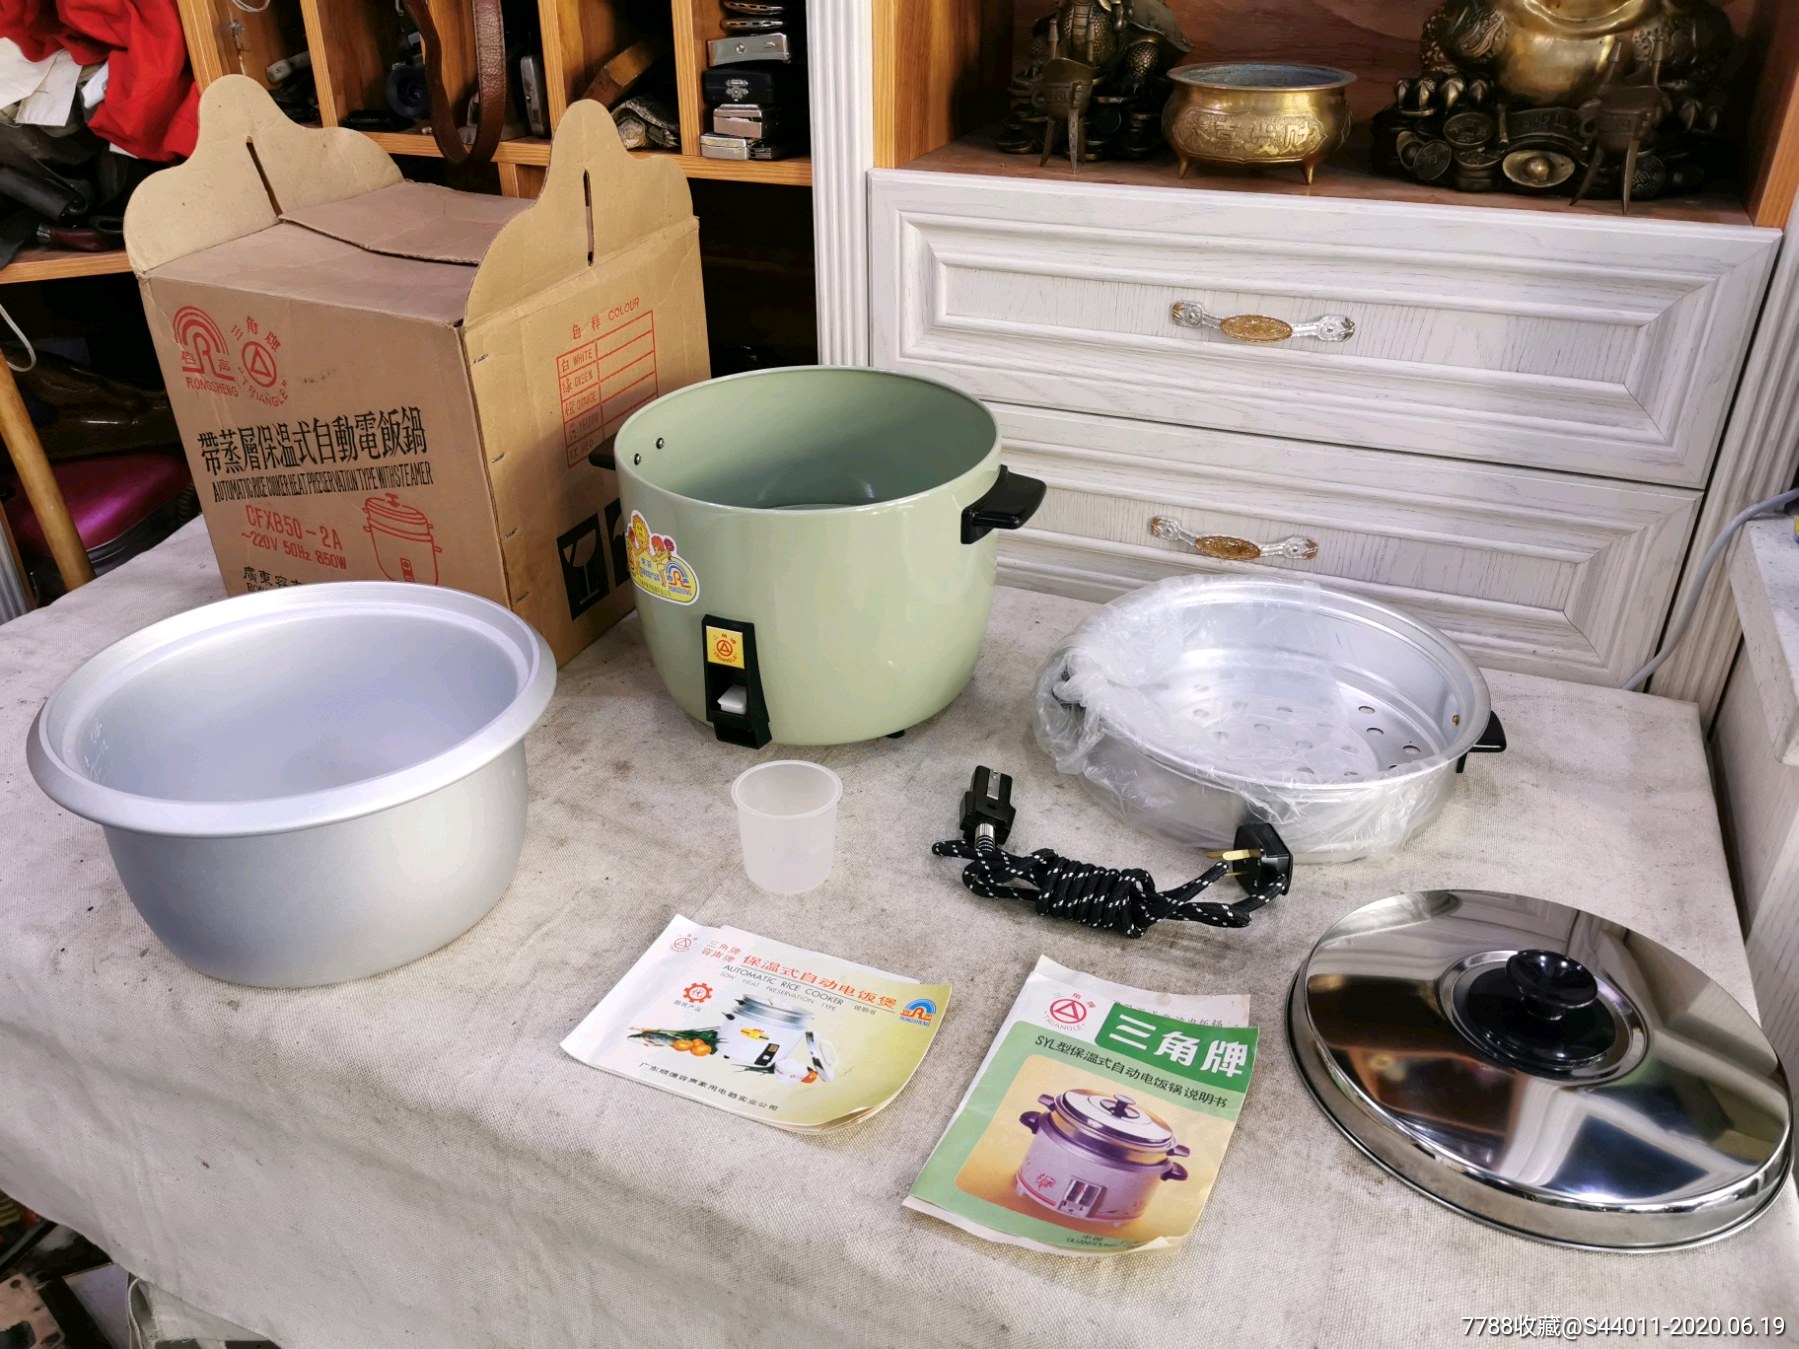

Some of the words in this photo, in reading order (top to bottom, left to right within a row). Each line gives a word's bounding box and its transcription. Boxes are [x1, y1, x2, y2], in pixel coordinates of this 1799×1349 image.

[608, 297, 639, 320] COLOUR
[573, 349, 593, 367] WHITE
[185, 377, 239, 398] RONGSHENG
[574, 370, 594, 386] GREEN
[212, 477, 252, 502] AUTOMATIC
[356, 467, 379, 491] TYPE
[283, 540, 312, 561] 50Hz
[315, 550, 347, 570] 850W
[723, 964, 777, 985] AUTOMATIC
[780, 980, 801, 992] RICE
[805, 988, 844, 1005] COOKER
[743, 955, 898, 1010] 保温式自动电饭煲
[766, 986, 814, 1004] PRESERVATION
[1108, 1014, 1249, 1078] 三角牌
